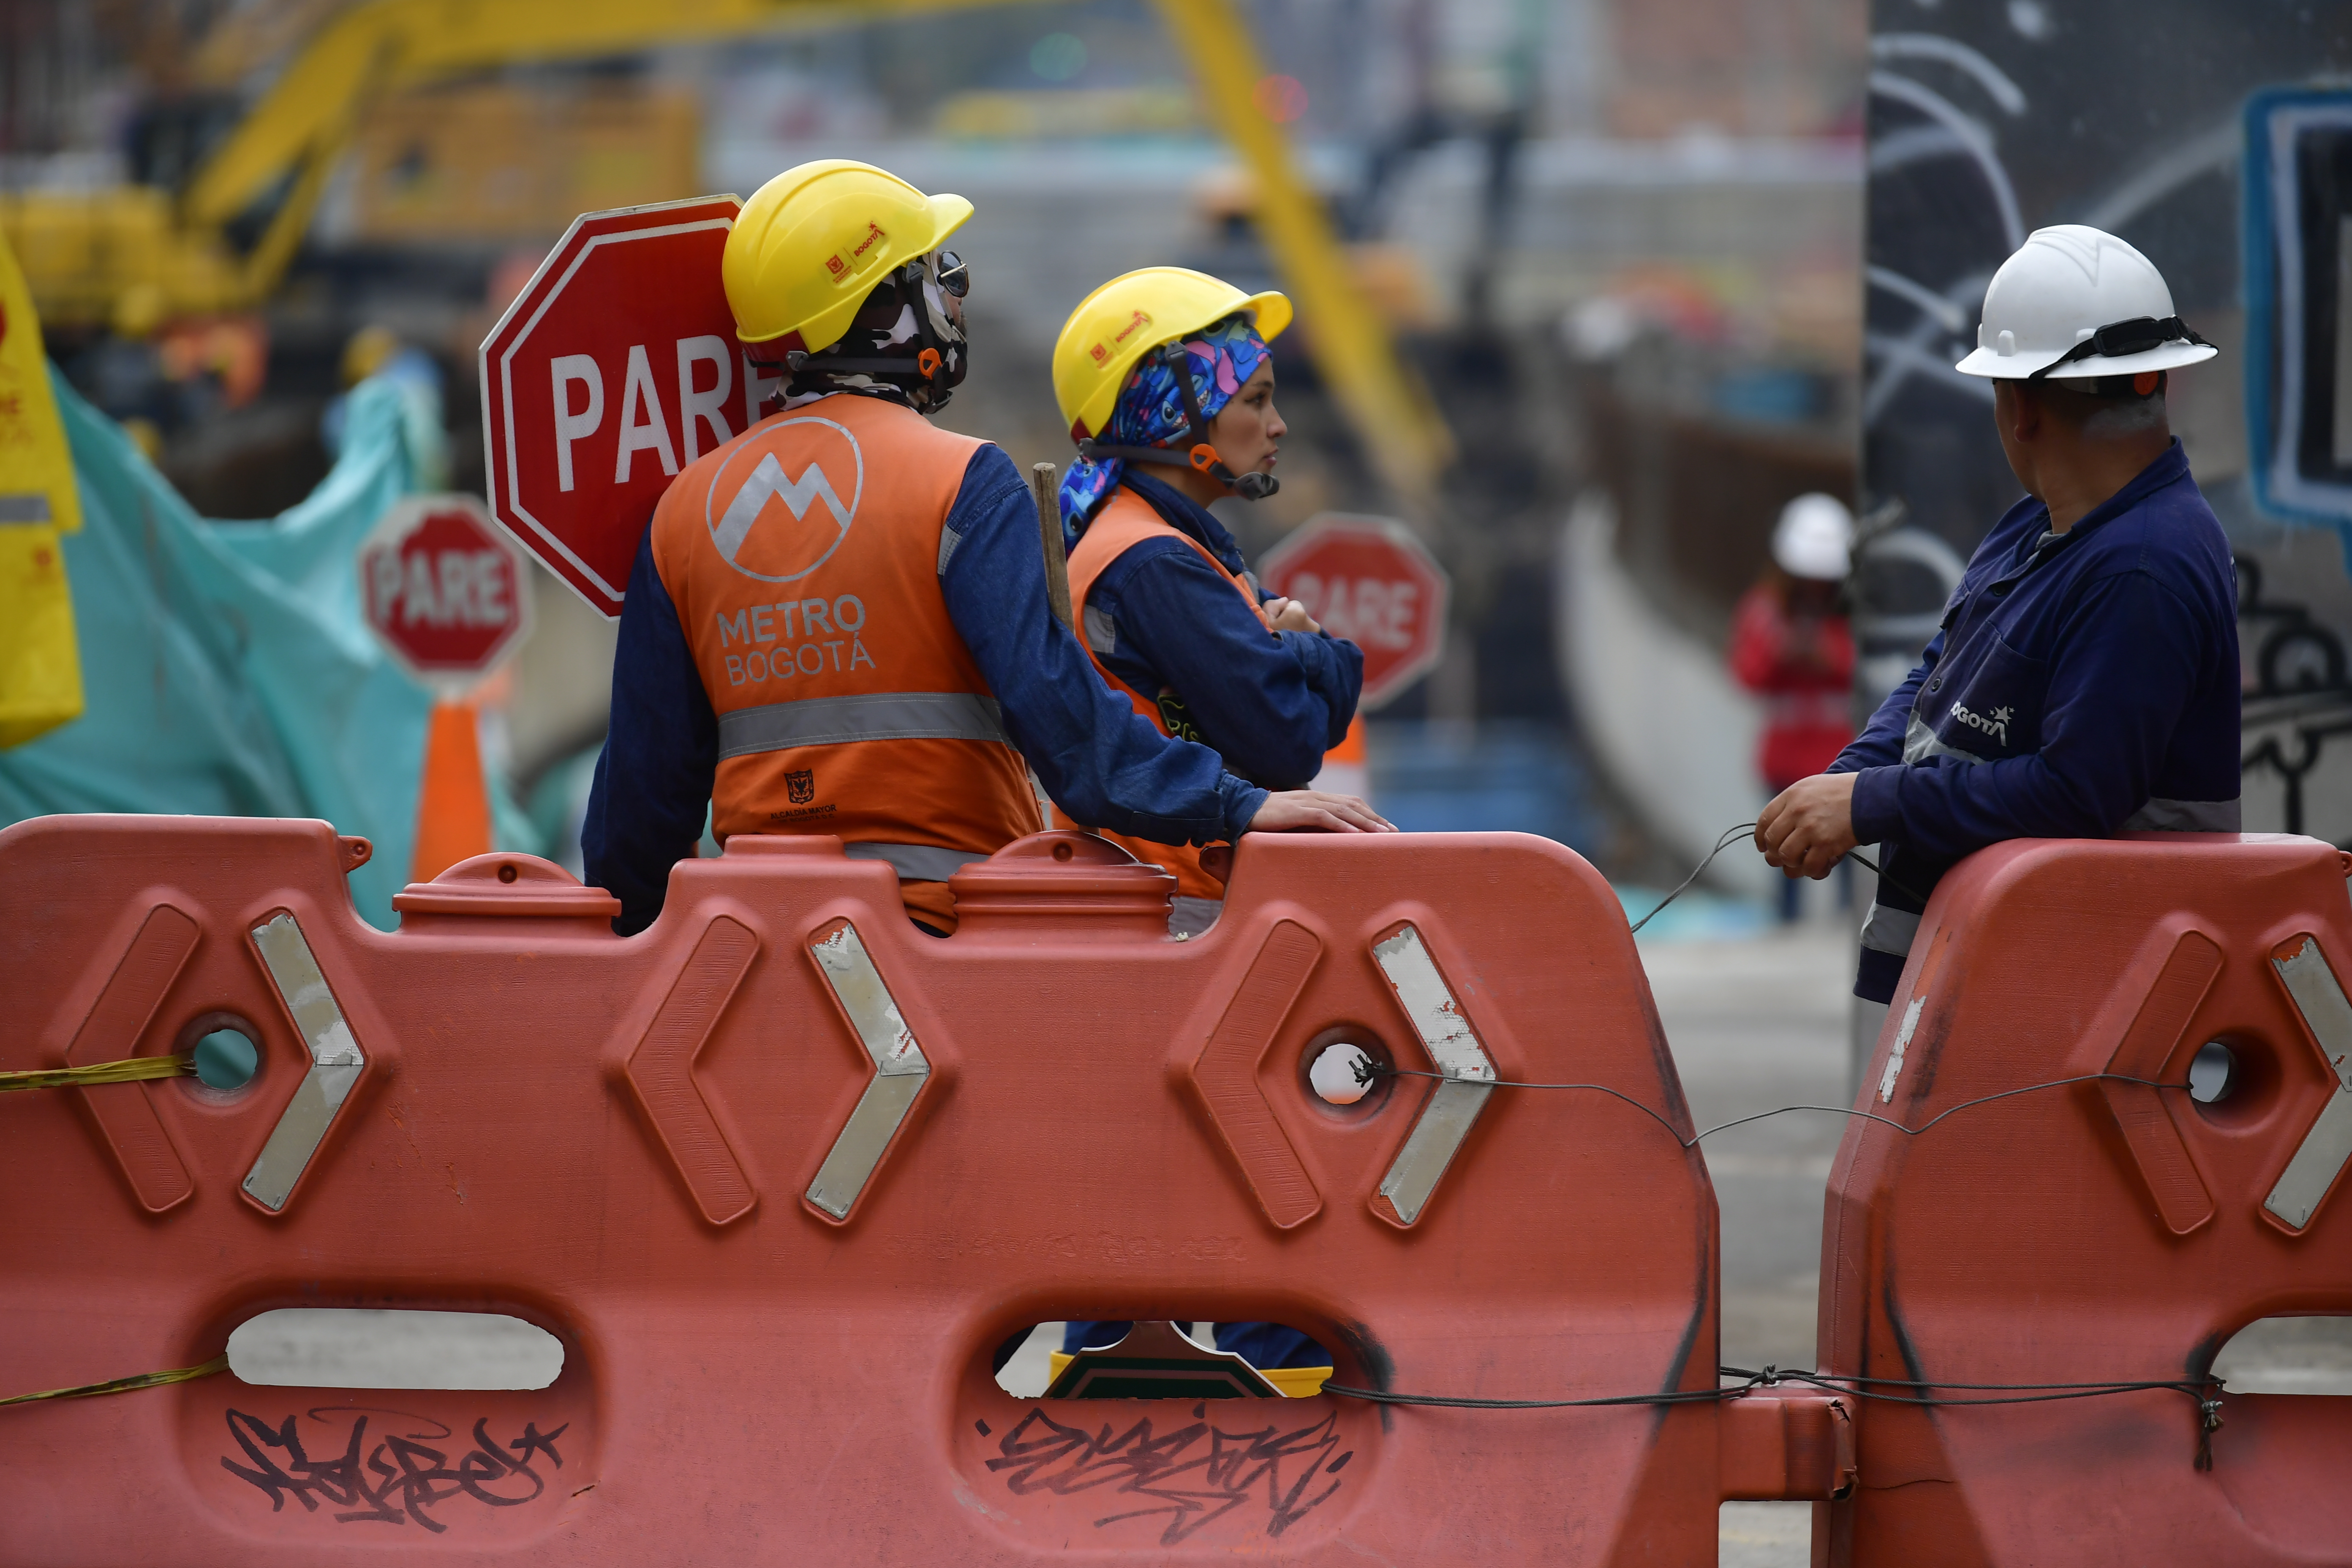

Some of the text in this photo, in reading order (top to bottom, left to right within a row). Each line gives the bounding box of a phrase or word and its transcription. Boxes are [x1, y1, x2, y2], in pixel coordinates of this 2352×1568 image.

[374, 550, 506, 622] PARE
[716, 594, 866, 648] METRO
[724, 631, 876, 686] BOGOTÁ
[770, 804, 837, 820] ALCALDÍA MAYOR
